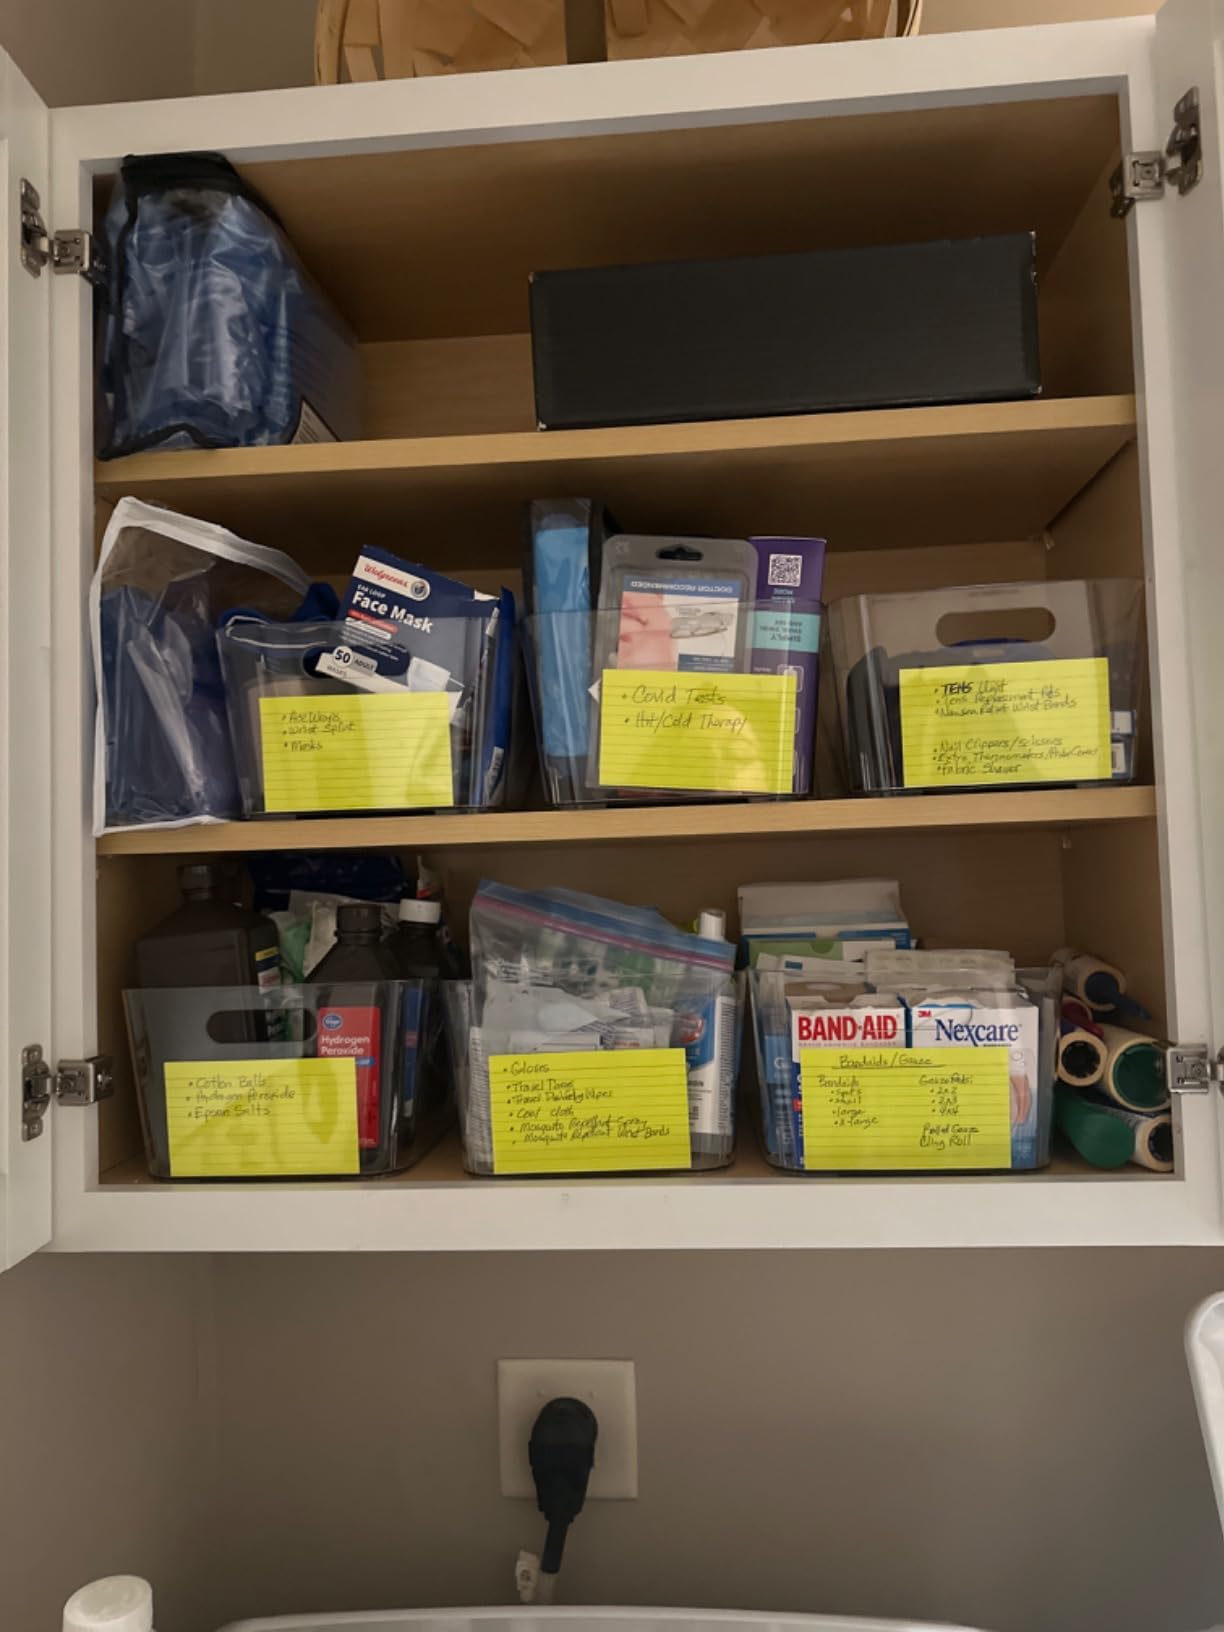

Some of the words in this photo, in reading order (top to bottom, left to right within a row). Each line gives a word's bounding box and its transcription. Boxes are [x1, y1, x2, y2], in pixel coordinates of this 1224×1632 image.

[364, 563, 408, 588] Walgreens
[351, 591, 389, 615] Face
[389, 605, 434, 634] Mask
[334, 649, 351, 664] 50
[631, 684, 677, 704] Covid
[686, 685, 727, 706] Tests
[699, 712, 748, 736] Therapy
[917, 1009, 932, 1019] 3M
[321, 1035, 370, 1047] Hydrogen
[935, 1018, 1019, 1047] Nexcare
[321, 1046, 365, 1055] Peroxide
[195, 1075, 233, 1090] Cotton
